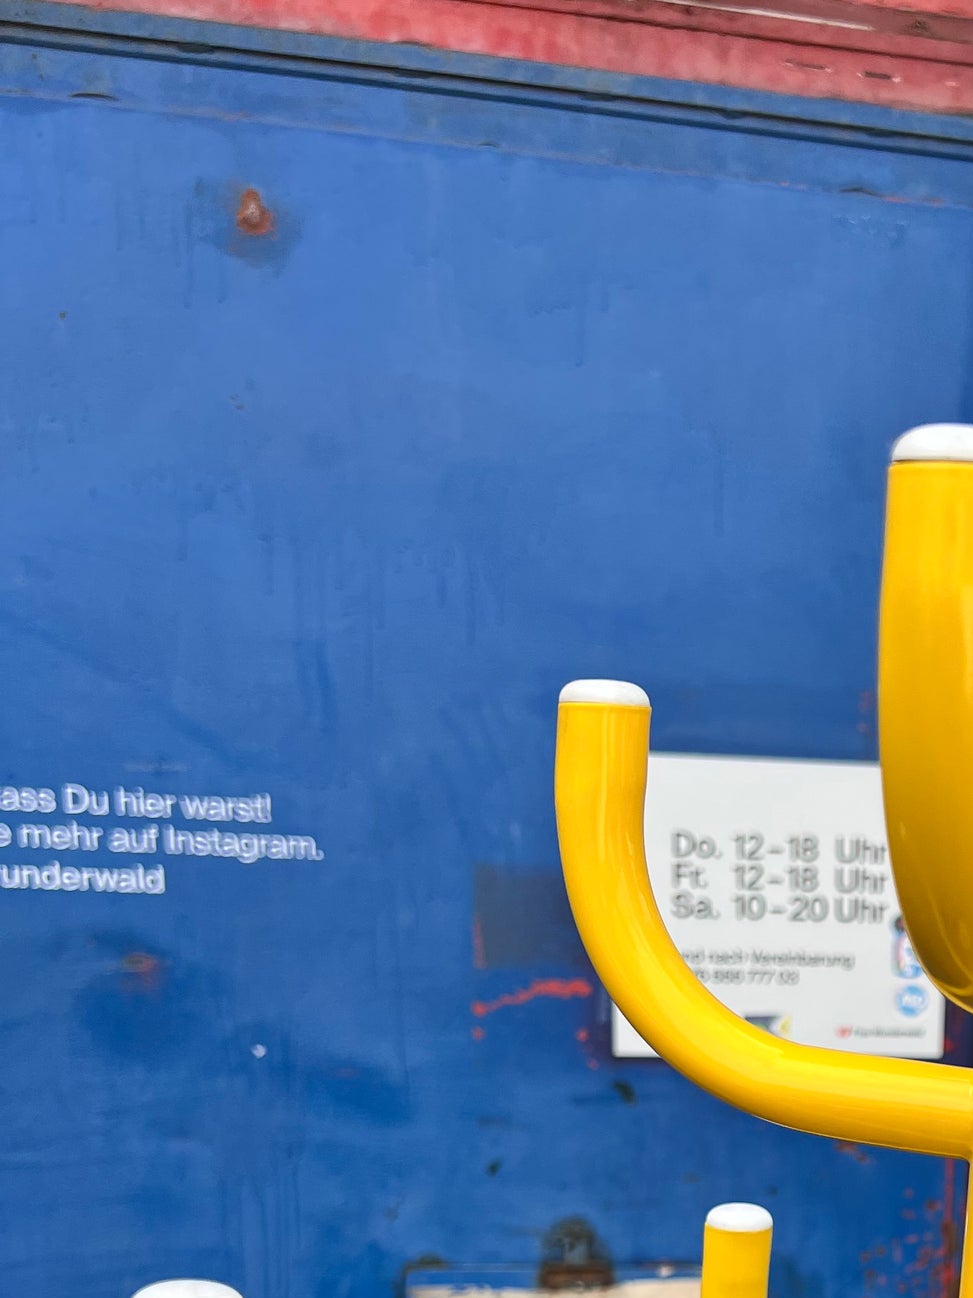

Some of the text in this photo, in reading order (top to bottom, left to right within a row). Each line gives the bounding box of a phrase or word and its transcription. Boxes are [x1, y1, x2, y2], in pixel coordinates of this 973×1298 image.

[61, 782, 110, 816] Du
[113, 785, 177, 818] hier
[178, 791, 272, 824] warst!
[17, 819, 104, 851] mehr
[106, 823, 160, 854] auf
[161, 823, 325, 864] Instagram.
[670, 828, 723, 860] Do.
[832, 833, 888, 865] Uhr
[832, 864, 889, 895] Uhr
[670, 890, 722, 920] Sa.
[832, 895, 889, 925] Uhr
